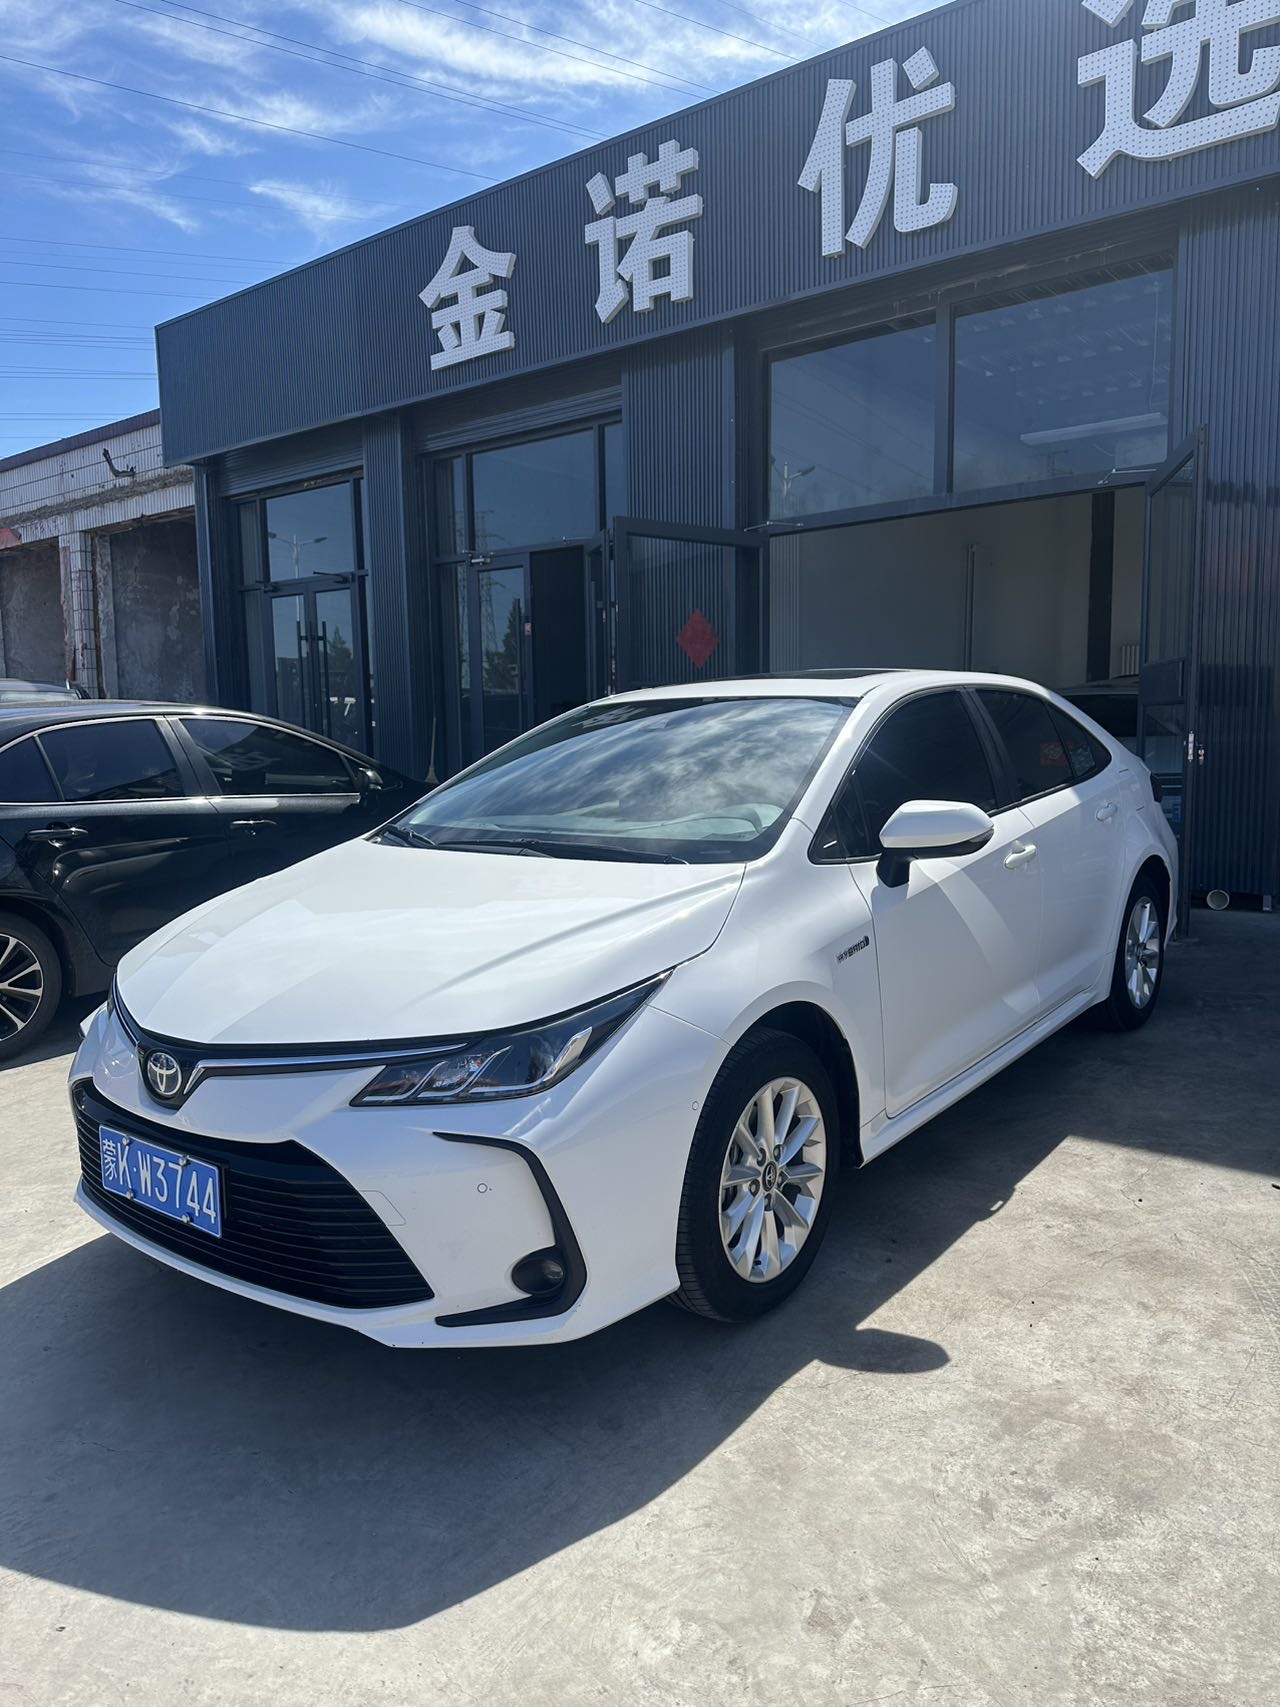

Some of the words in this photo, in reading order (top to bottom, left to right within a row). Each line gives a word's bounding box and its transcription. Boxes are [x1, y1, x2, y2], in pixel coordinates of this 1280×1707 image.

[419, 0, 1280, 370] 金诺优选
[837, 938, 866, 963] HYBRID
